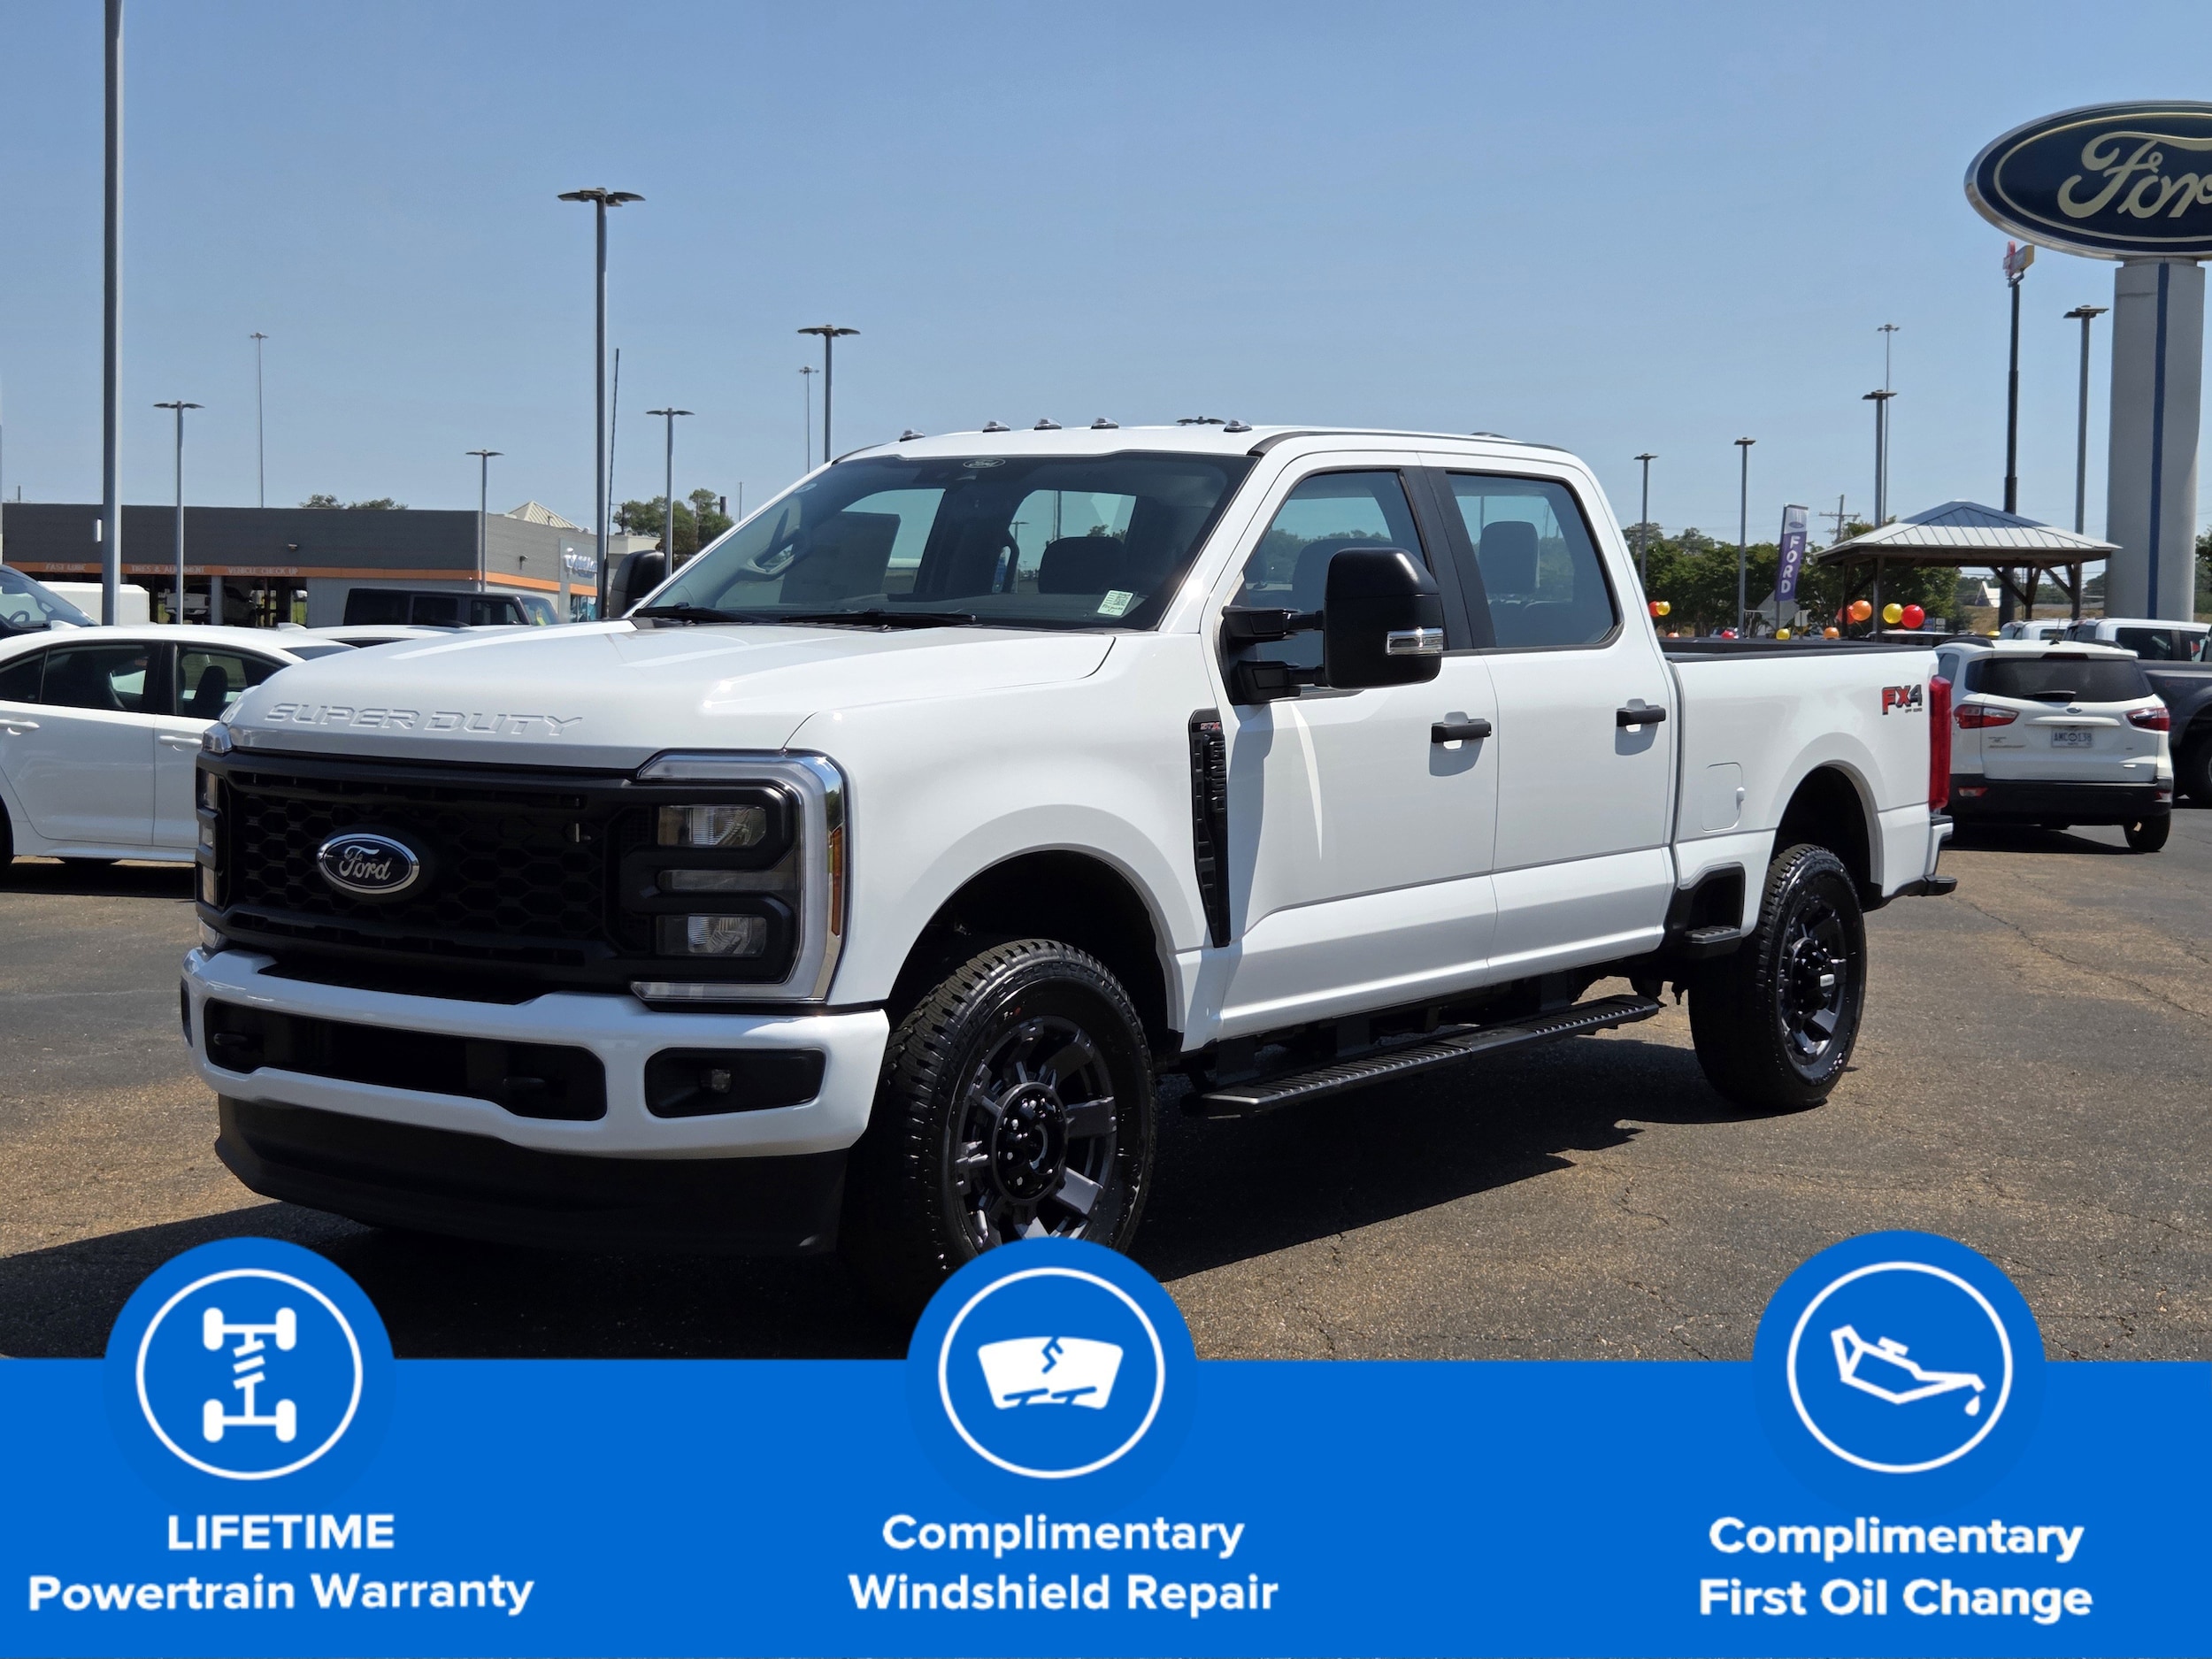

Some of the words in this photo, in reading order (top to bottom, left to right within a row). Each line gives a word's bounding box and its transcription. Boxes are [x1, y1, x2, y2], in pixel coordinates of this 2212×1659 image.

[45, 563, 65, 572] FAST
[66, 564, 87, 572] LUBE
[1780, 534, 1801, 594] FORD
[1882, 684, 1923, 715] FX4
[265, 703, 420, 730] SUPER
[424, 711, 584, 736] DUTY
[339, 845, 393, 880] Ford
